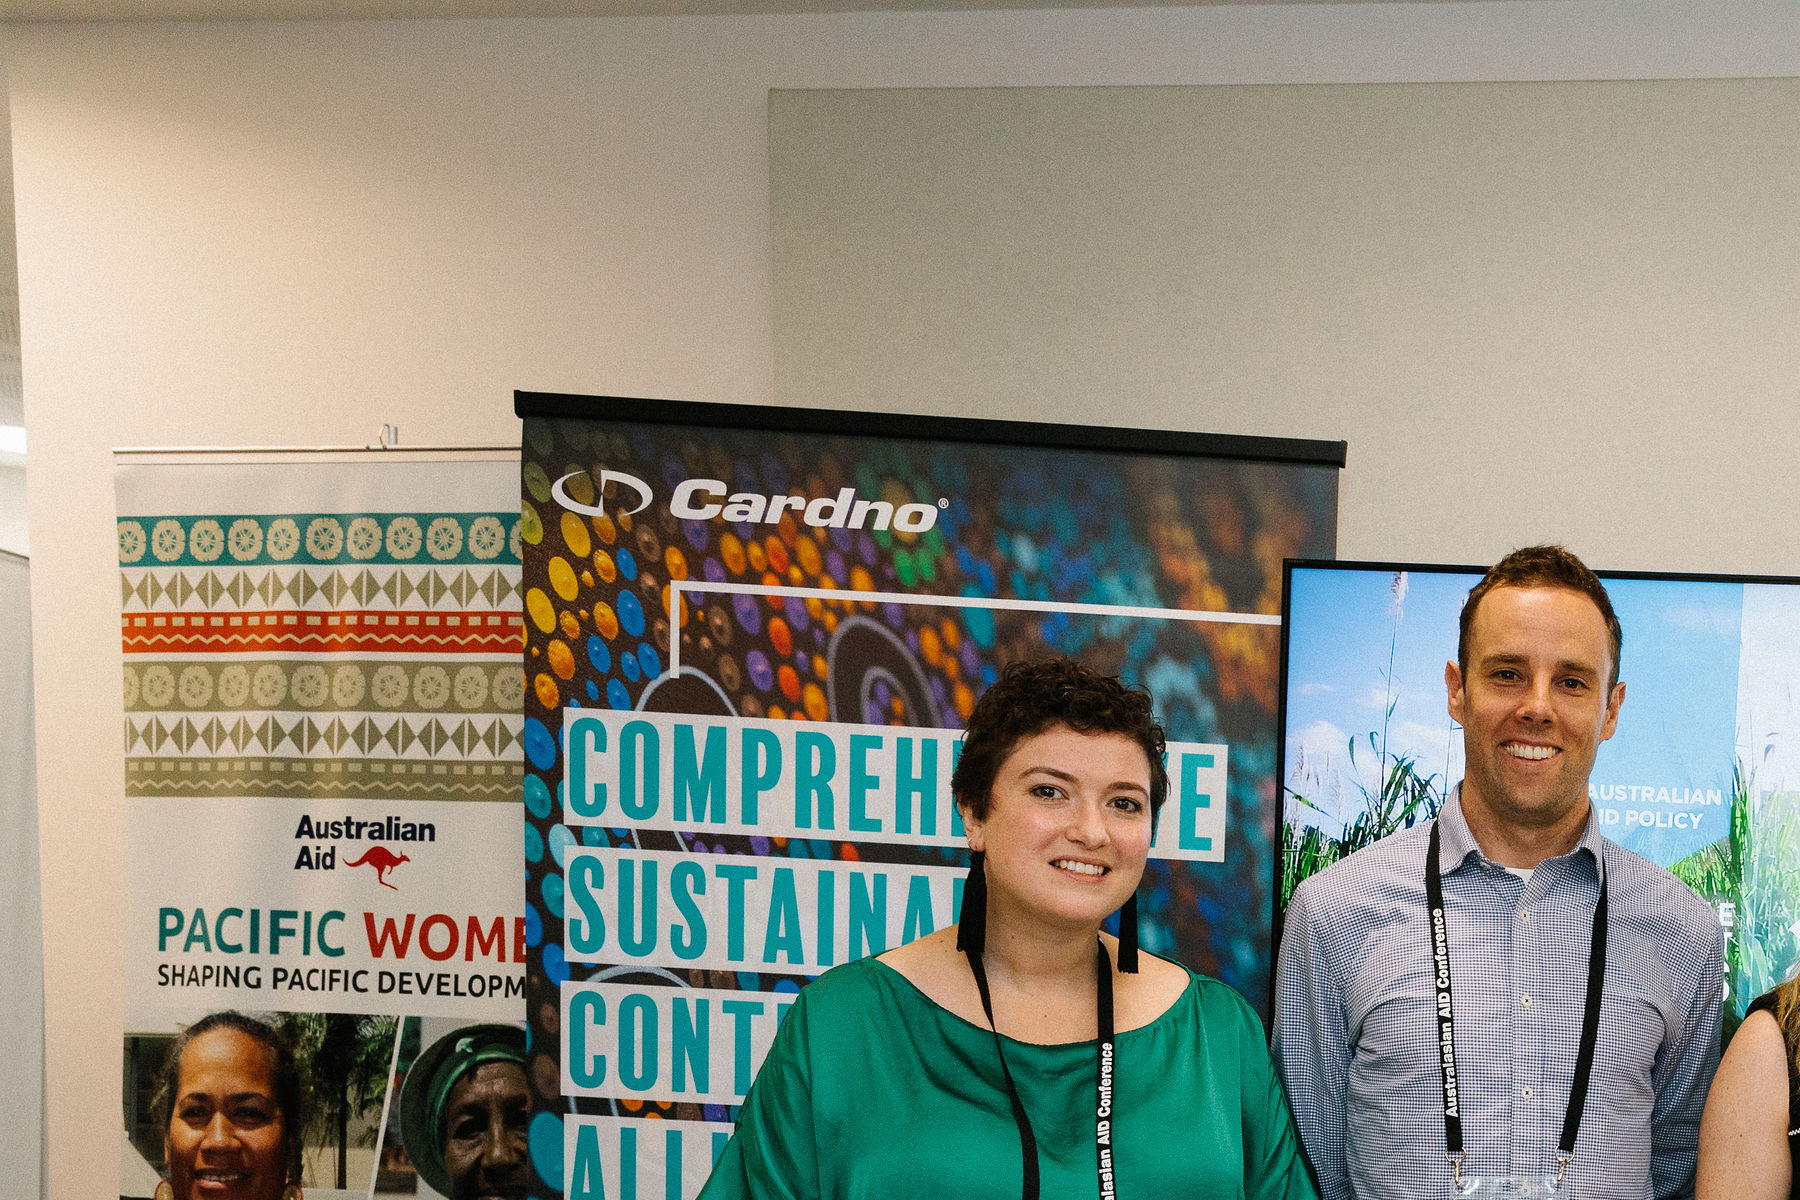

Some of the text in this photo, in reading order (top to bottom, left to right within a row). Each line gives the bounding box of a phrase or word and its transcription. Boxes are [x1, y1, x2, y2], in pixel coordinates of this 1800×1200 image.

[1589, 784, 1721, 805] AUSTRALIAN
[295, 814, 435, 842] Australian
[1626, 810, 1703, 829] POLICY
[295, 846, 336, 870] Aid
[568, 855, 968, 967] SUSTAINA
[158, 907, 526, 963] PACIFIC WOM
[158, 964, 526, 999] SHAPING PACIFIC DEVELOPM
[1433, 908, 1458, 1117] Australasian AID Conference
[1098, 1043, 1113, 1118] Conference
[1097, 1121, 1110, 1144] AID
